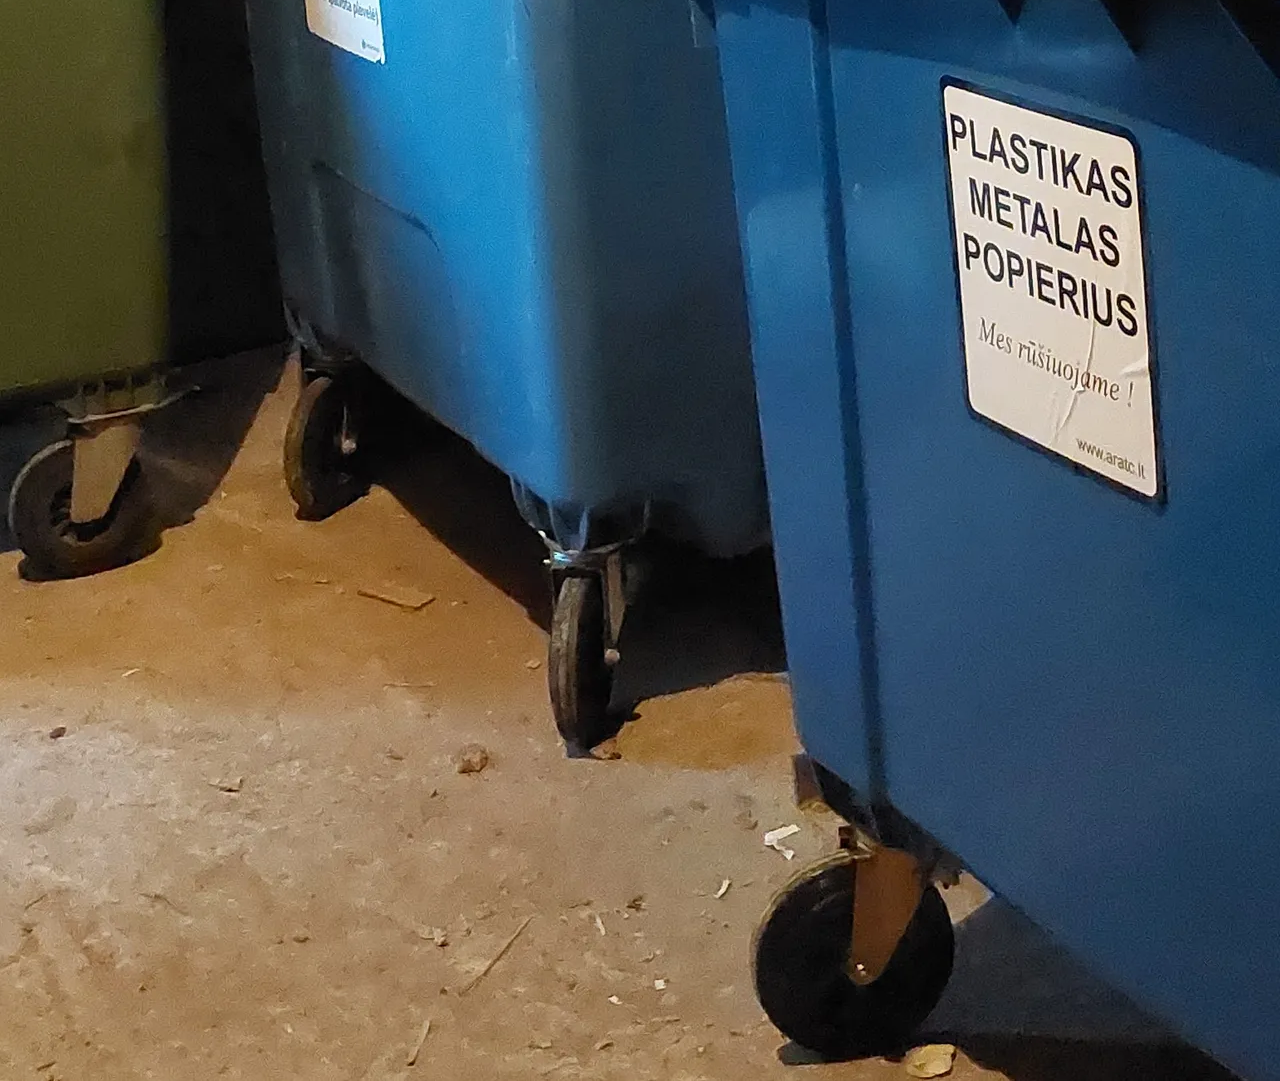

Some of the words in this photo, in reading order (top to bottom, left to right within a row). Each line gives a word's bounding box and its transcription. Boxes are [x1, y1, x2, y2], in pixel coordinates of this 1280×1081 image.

[950, 113, 1132, 208] PLASTIKAS
[969, 177, 1120, 267] METALAS
[963, 233, 1138, 336] POPIERIUS
[978, 317, 1013, 354] Mes
[1018, 340, 1120, 401] rūšiuojame
[1076, 438, 1146, 479] www.aratc.lt
